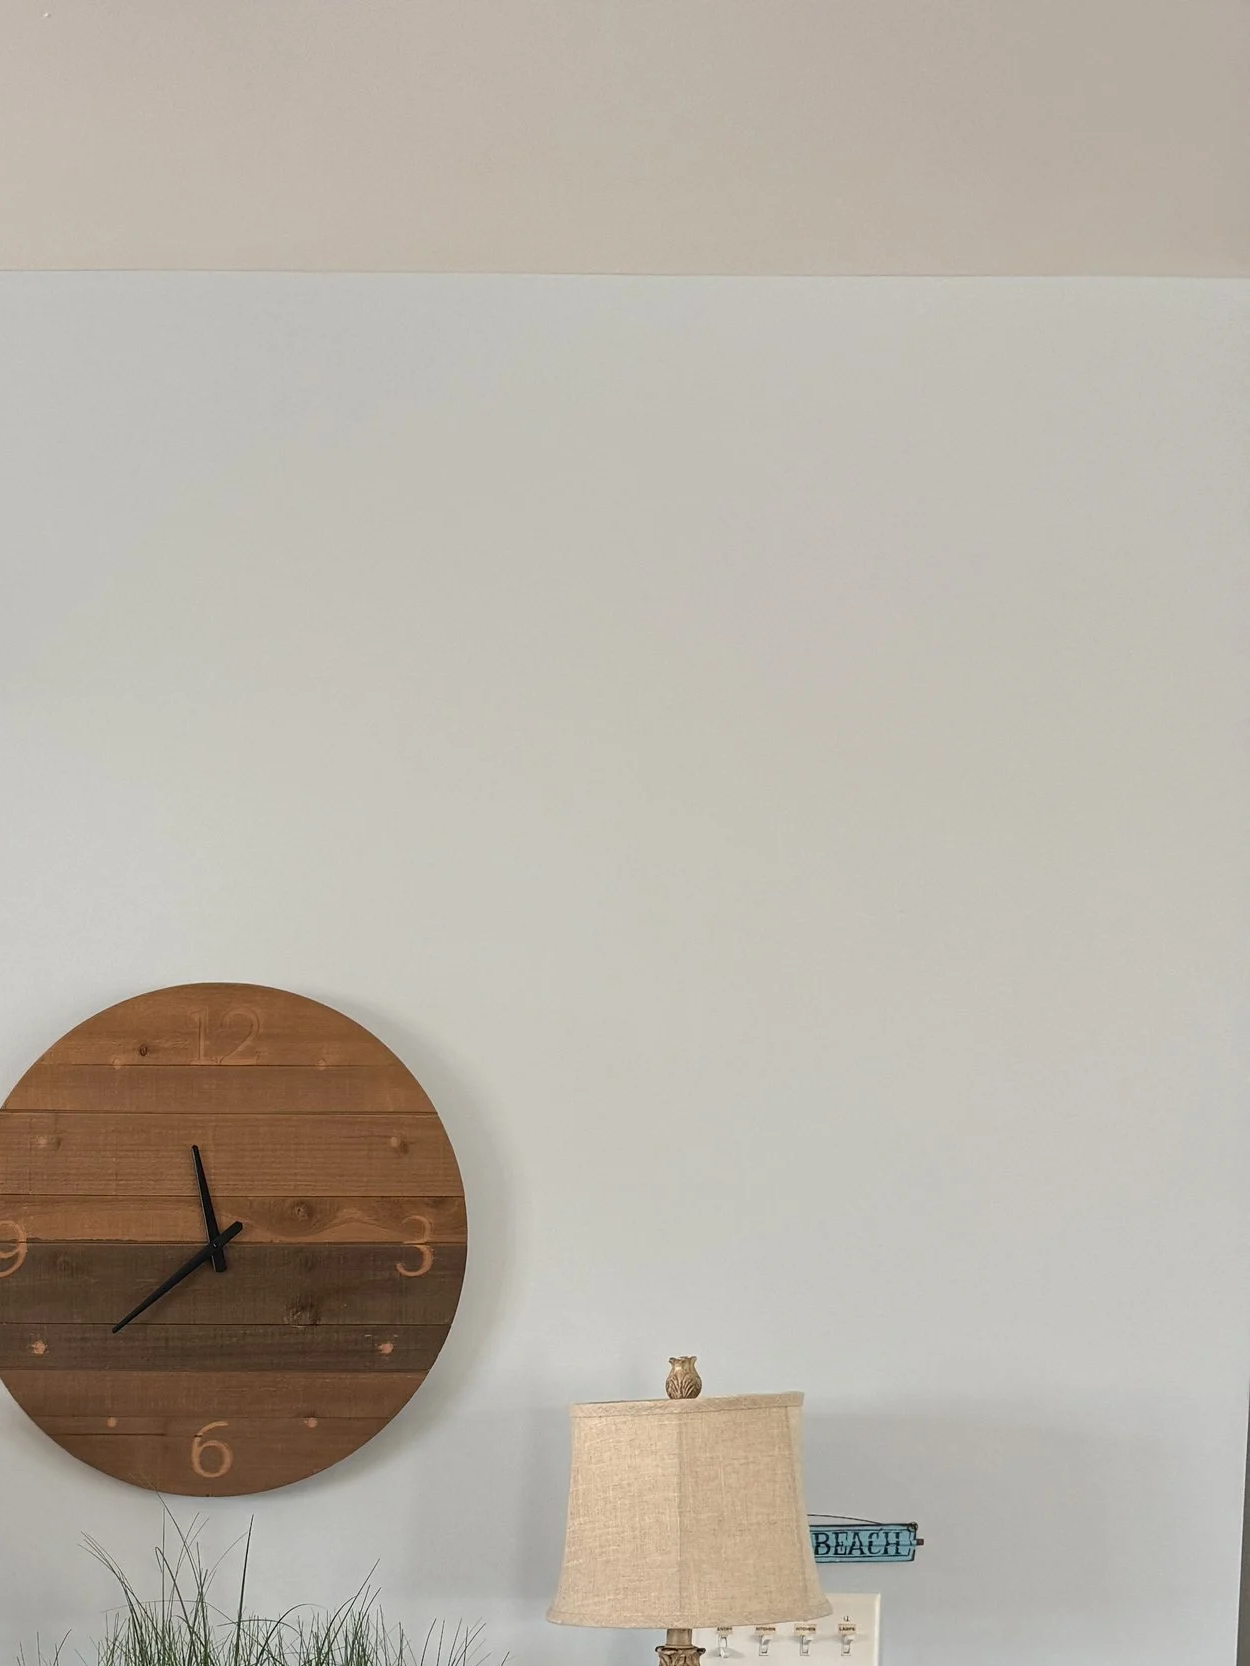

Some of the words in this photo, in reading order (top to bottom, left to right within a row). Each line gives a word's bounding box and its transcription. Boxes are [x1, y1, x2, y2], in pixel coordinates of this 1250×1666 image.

[188, 1005, 262, 1064] 12
[395, 1215, 434, 1277] 3
[191, 1421, 233, 1478] 6
[812, 1530, 903, 1556] BEACH
